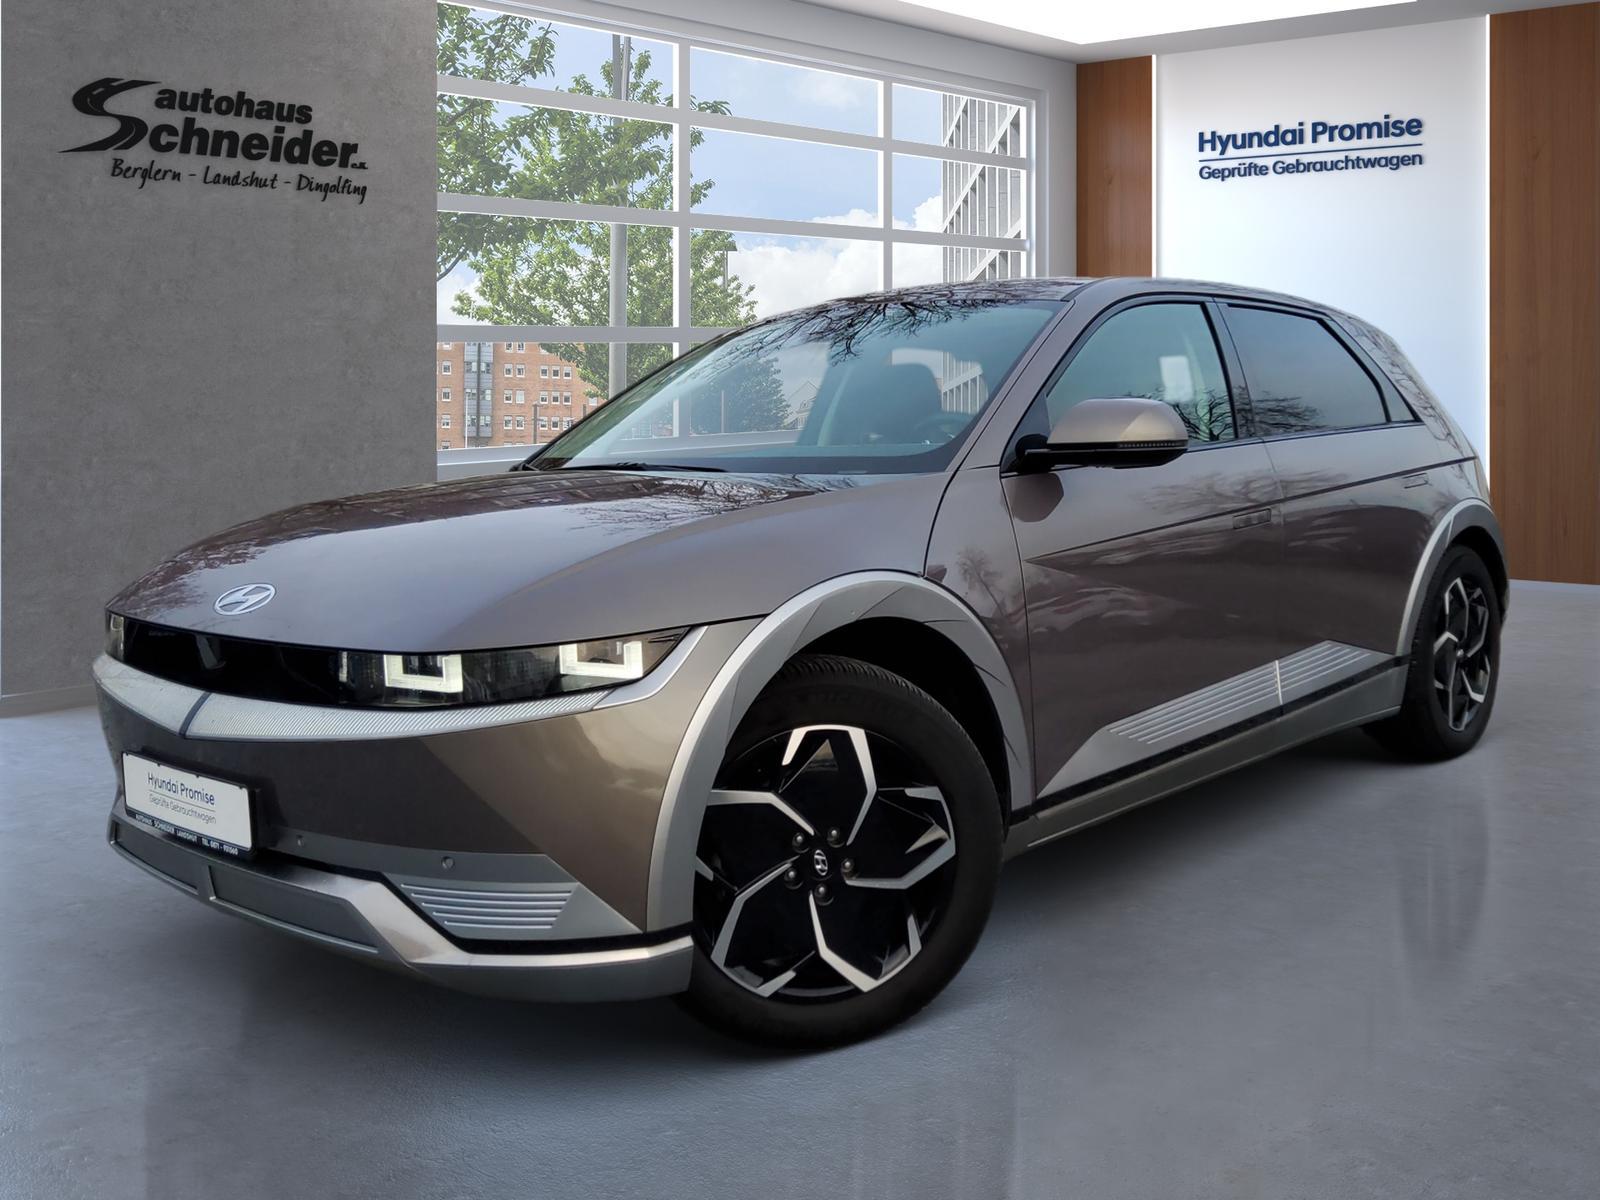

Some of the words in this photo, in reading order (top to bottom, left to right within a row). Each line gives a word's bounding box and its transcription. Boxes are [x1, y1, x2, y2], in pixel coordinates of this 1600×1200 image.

[154, 87, 313, 124] autohaus
[1198, 121, 1304, 156] Hyundai
[1311, 114, 1423, 144] Promise
[111, 158, 182, 189] Berglern
[203, 165, 279, 190] Landshut
[296, 173, 368, 205] Dingolfing
[1199, 162, 1269, 182] Geprüfte
[1272, 153, 1423, 176] Gebrauchtwagen
[147, 772, 179, 797] Hyundai
[180, 782, 215, 806] Promise
